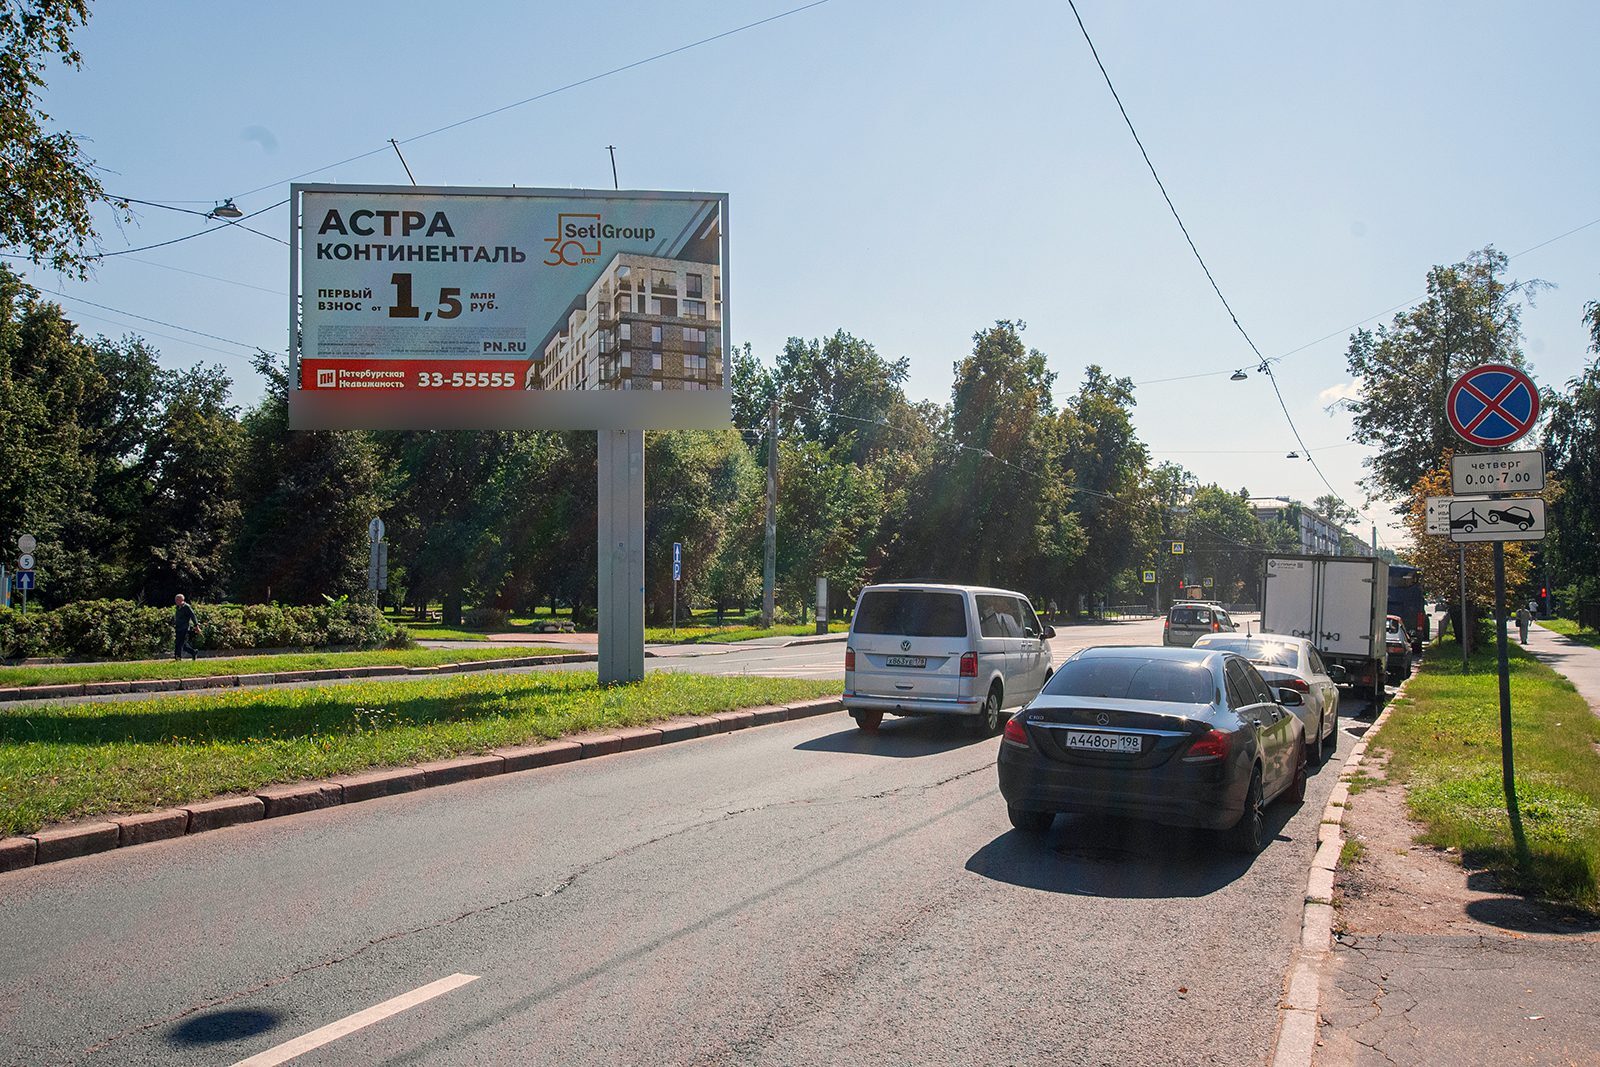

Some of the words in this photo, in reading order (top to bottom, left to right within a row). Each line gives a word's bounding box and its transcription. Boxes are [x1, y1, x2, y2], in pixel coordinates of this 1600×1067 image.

[317, 208, 456, 238] АСТРА
[316, 242, 527, 263] КОНТИНЕНТАЛЬ
[317, 287, 373, 300] ПЕРВЫЙ
[388, 272, 464, 322] 1,5
[469, 291, 496, 300] млн
[317, 301, 363, 312] ВЗНОС
[469, 300, 499, 313] руб.
[483, 341, 527, 352] PN.RU
[338, 369, 405, 379] Петербургская
[417, 371, 516, 388] 33-55555
[338, 379, 405, 389] Недвижимость
[1471, 460, 1521, 470] четверг
[1465, 472, 1531, 485] 0.00-7.00
[24, 558, 30, 566] 5
